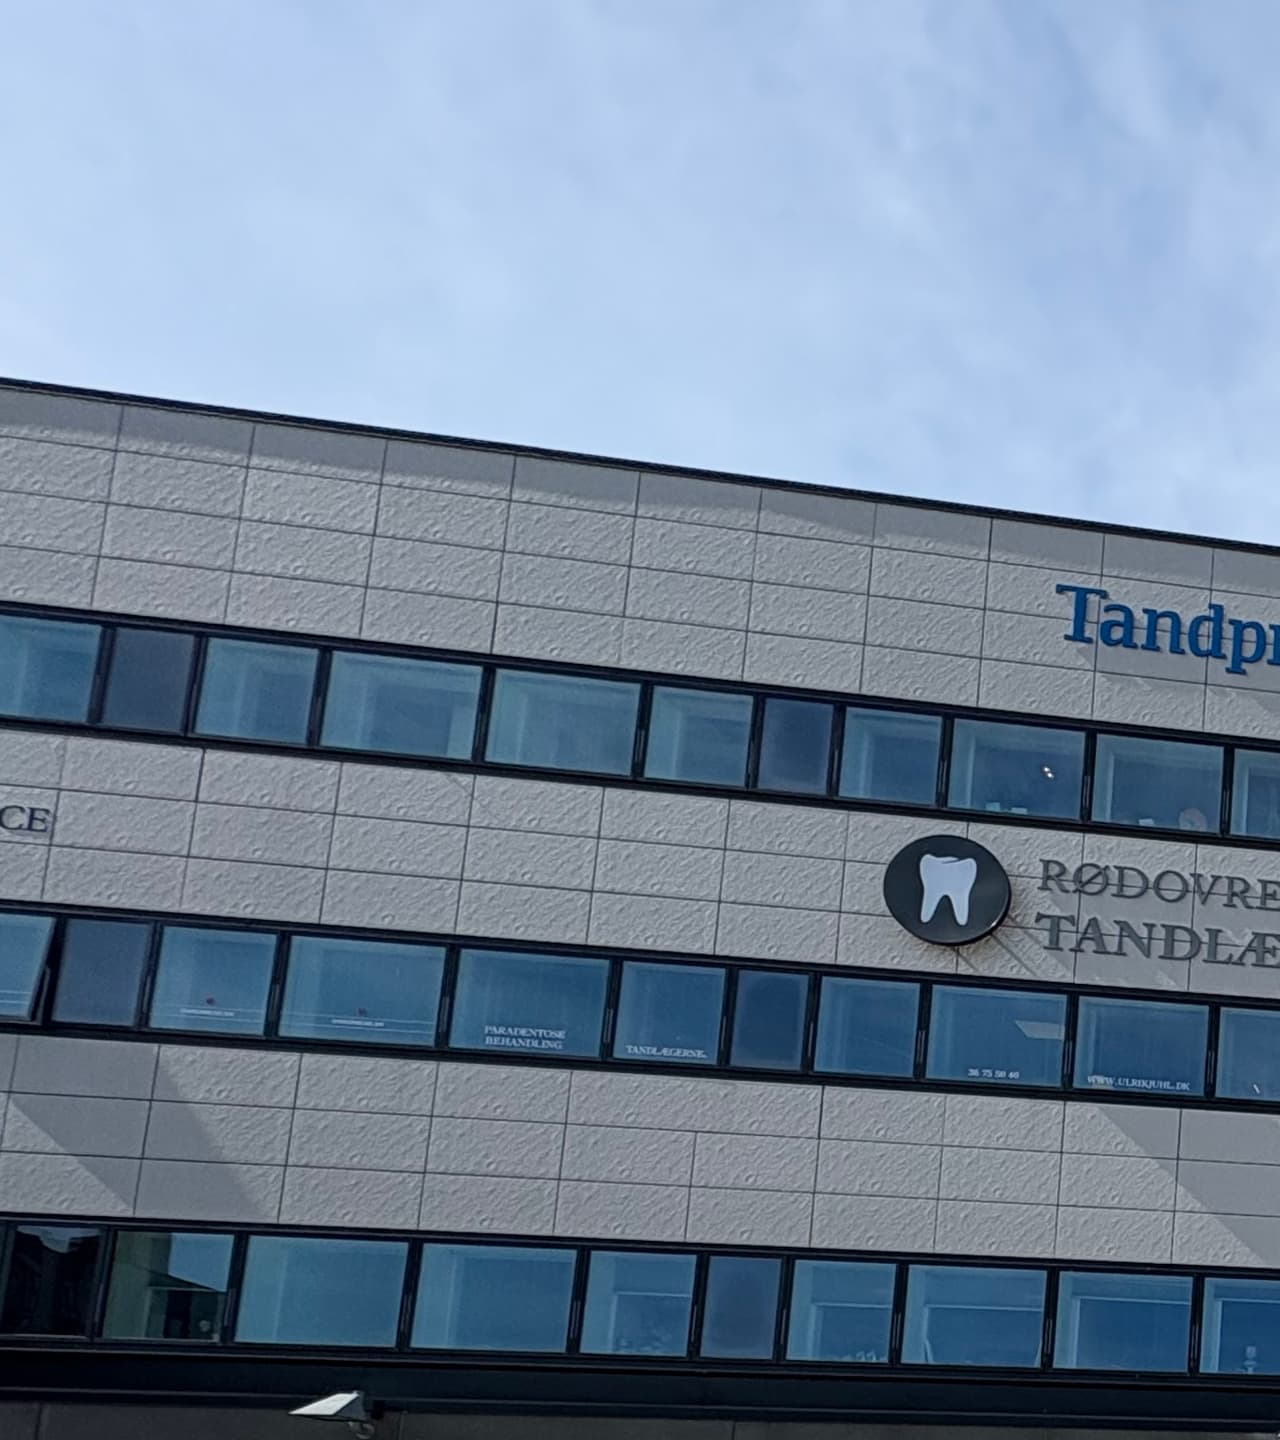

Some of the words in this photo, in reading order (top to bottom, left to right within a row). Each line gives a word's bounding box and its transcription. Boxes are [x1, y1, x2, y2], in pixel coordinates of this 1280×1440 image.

[0, 804, 51, 833] CE
[483, 1024, 567, 1040] PARADENTOSE
[484, 1035, 564, 1050] BEHANDLING
[1087, 1074, 1191, 1092] WWW.ULRIKJUHL.DK
